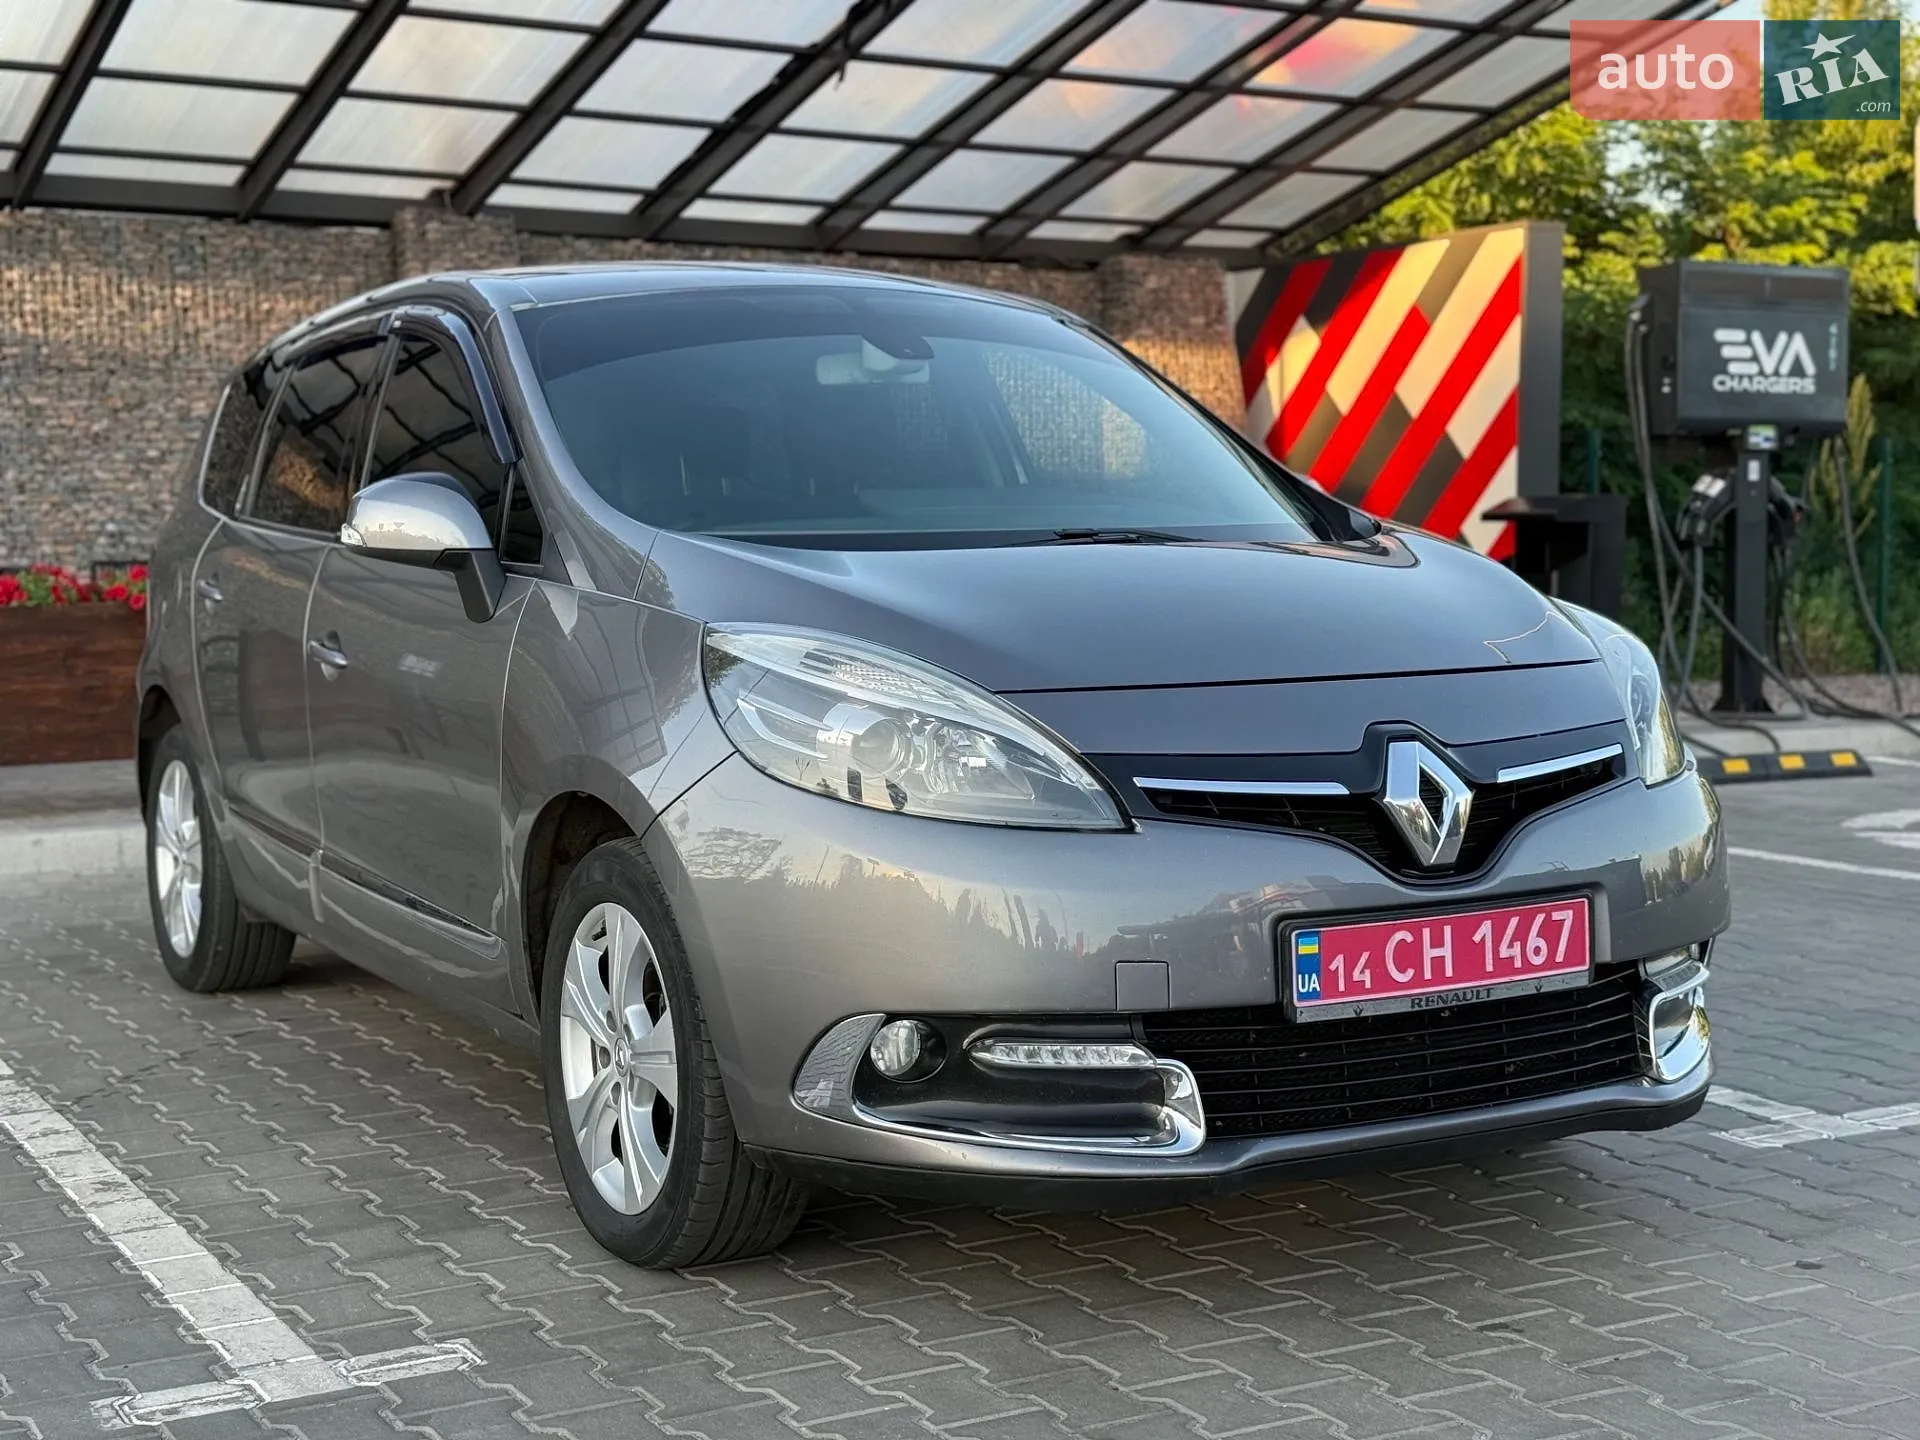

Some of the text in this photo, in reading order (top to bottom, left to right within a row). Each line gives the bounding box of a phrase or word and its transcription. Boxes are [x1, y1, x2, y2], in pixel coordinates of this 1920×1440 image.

[1713, 328, 1817, 376] EVA
[1712, 374, 1816, 394] CHARGERS
[1328, 909, 1573, 992] 14 CH 1467
[1299, 973, 1320, 992] UA
[1410, 987, 1495, 1010] RENAULT
